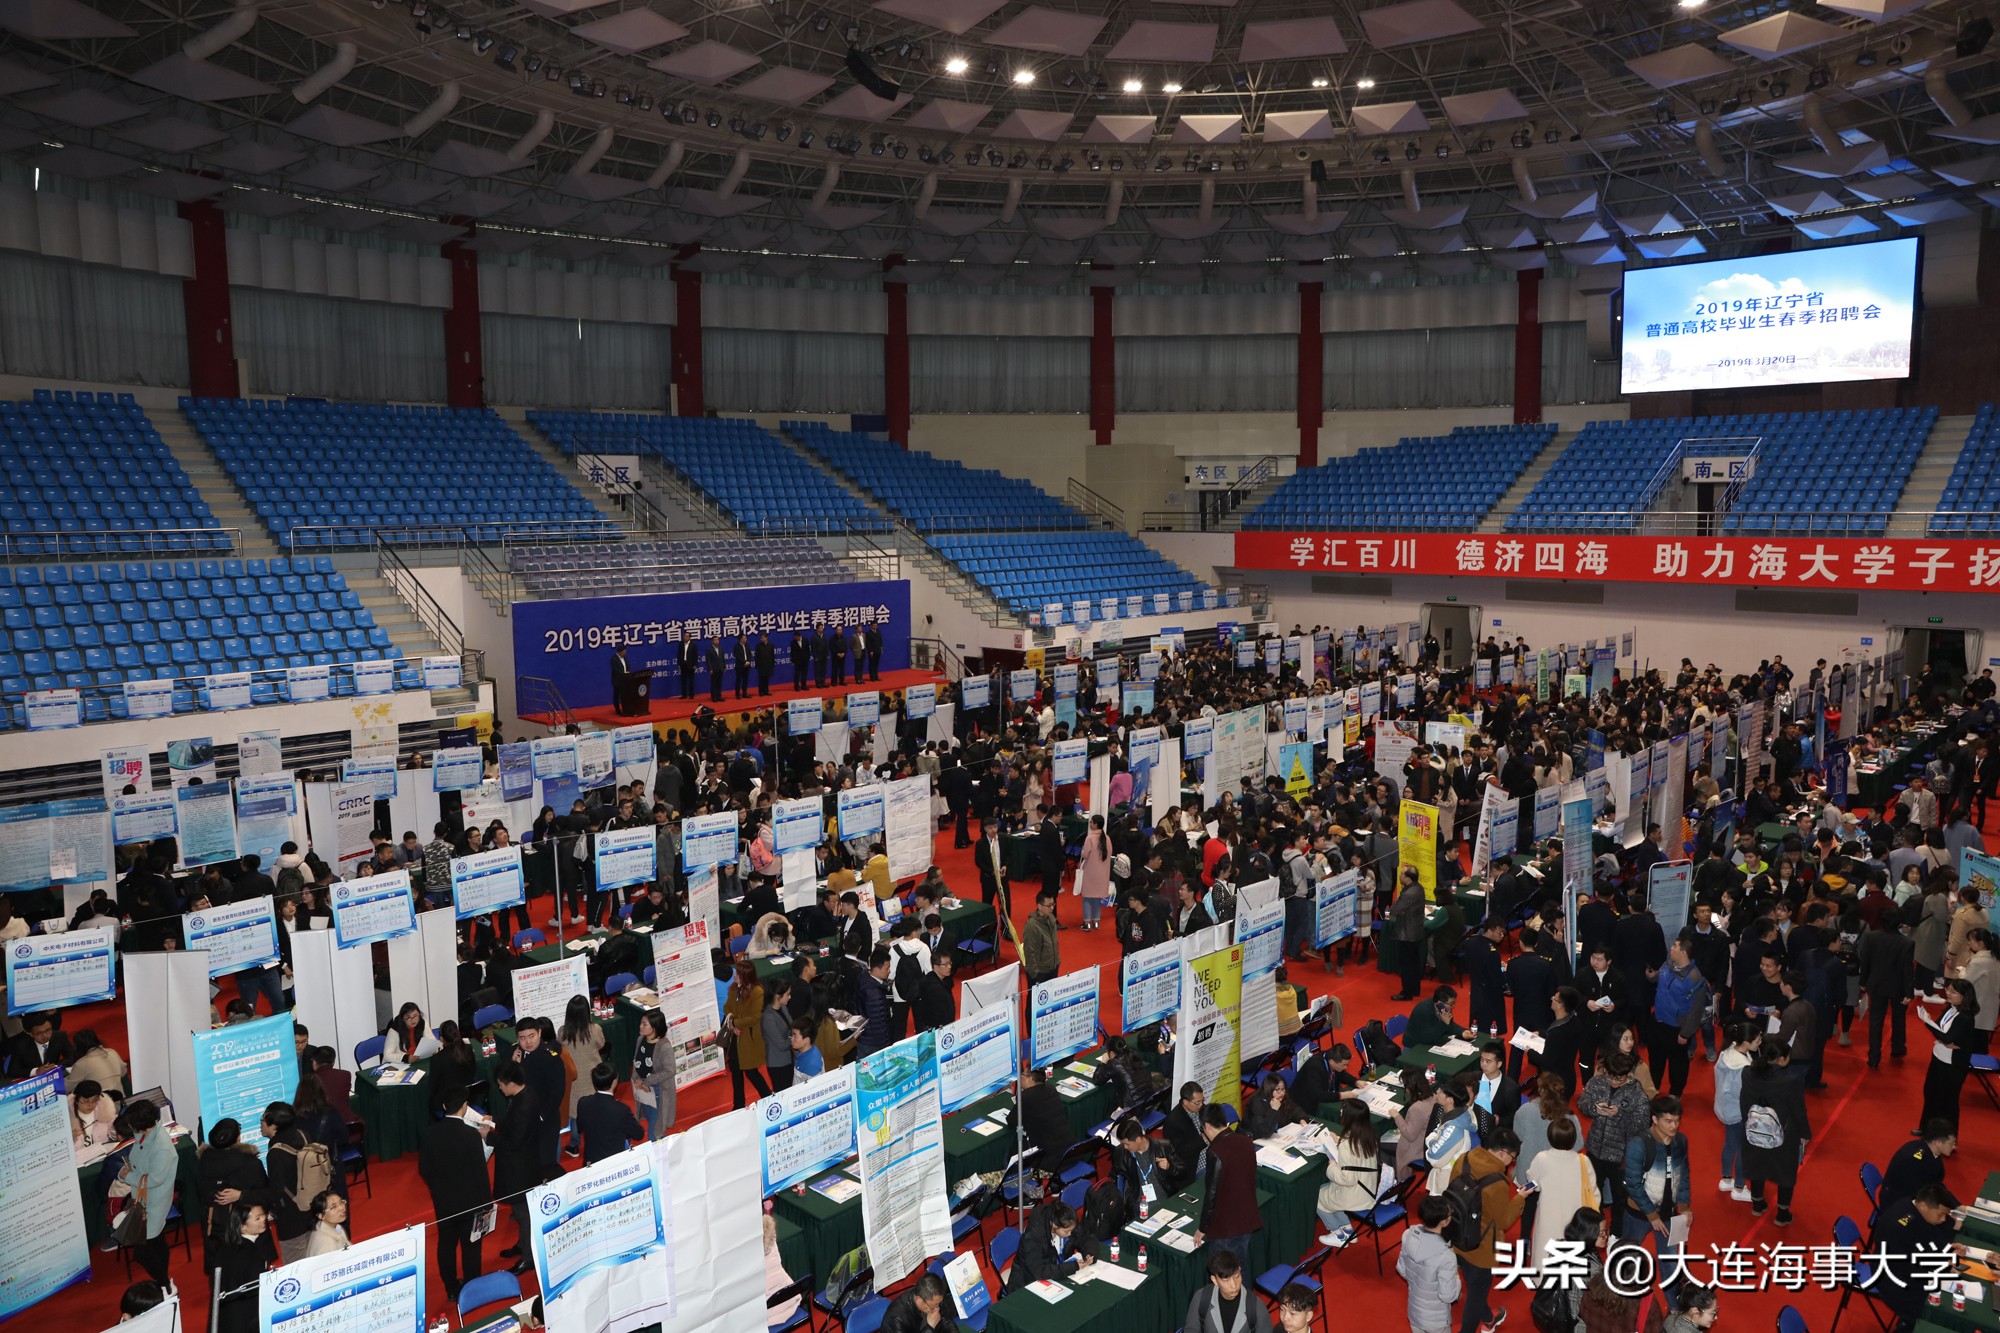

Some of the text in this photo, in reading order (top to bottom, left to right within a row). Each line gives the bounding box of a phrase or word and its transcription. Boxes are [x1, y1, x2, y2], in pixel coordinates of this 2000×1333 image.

[1695, 291, 1825, 316] 2019年辽宁省
[1645, 303, 1882, 338] 普通高校毕业生春季招聘会
[1290, 537, 2000, 586] 学汇百川 德济四海 助力海大学子扬
[544, 604, 891, 653] 2019年辽宁省普通高校毕业生春季招聘会
[109, 758, 143, 779] 招聘
[338, 795, 371, 811] CRRC
[43, 938, 104, 951] 中天电子材料有限公司
[1193, 969, 1210, 985] WE
[1194, 978, 1221, 998] NEED
[1194, 995, 1216, 1012] YOU
[21, 1084, 58, 1115] 招聘
[587, 1200, 600, 1209] 人数
[323, 1248, 405, 1283] 江苏骆氏减震件有限公司
[296, 1275, 393, 1315] 岗位 人数 专业
